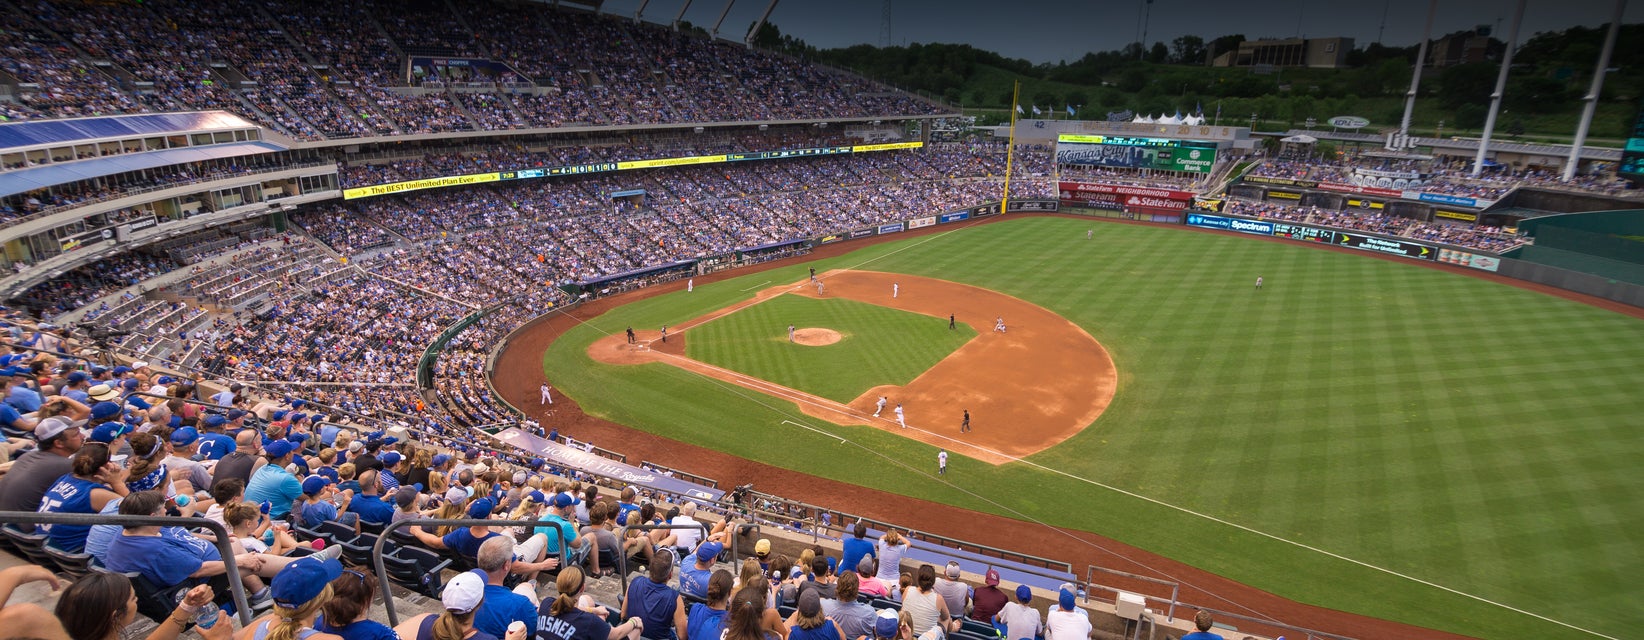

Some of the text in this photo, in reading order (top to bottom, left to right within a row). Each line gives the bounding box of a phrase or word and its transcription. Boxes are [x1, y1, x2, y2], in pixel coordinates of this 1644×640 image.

[1034, 121, 1045, 129] 42
[1177, 126, 1190, 135] 20
[1199, 127, 1210, 136] 10
[1222, 128, 1229, 136] 5
[1384, 132, 1421, 151] Lite
[1058, 144, 1126, 163] Kansas City
[1176, 157, 1211, 166] Commerce
[1184, 164, 1201, 172] Bank
[371, 187, 386, 196] The
[386, 184, 404, 192] BEST
[405, 180, 441, 190] Unlimited
[442, 178, 458, 186] Plan
[1116, 187, 1170, 198] NEIGHBORHOOD
[1219, 220, 1229, 228] City
[1231, 220, 1270, 233] Spectrum
[1377, 240, 1401, 248] Network
[541, 446, 656, 483] HOME OF THE Royals
